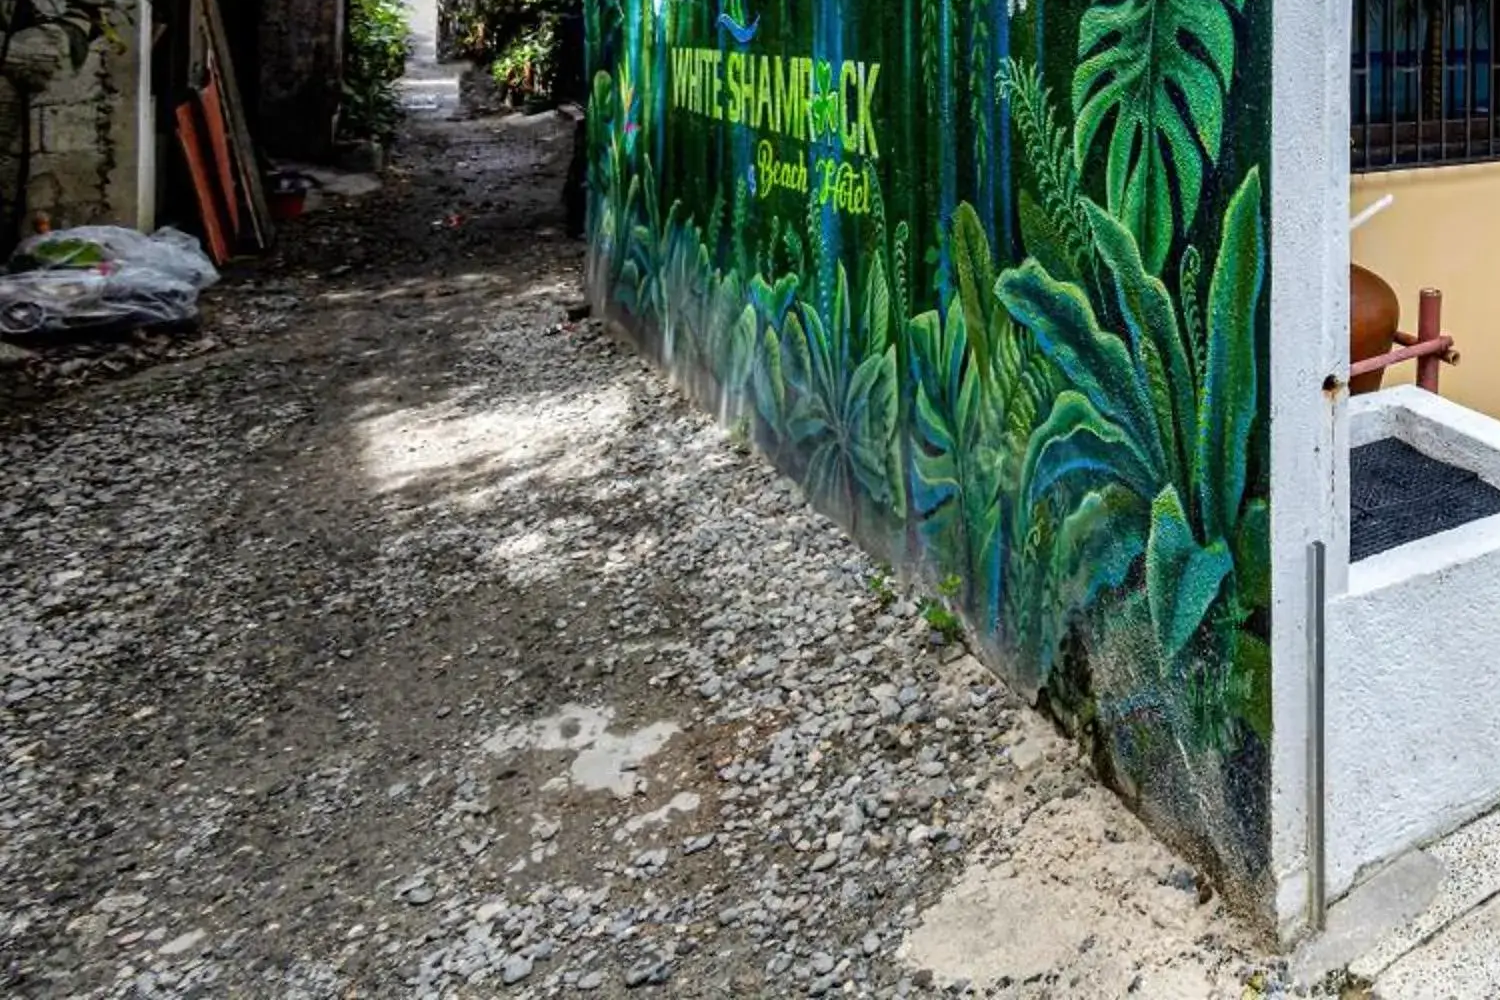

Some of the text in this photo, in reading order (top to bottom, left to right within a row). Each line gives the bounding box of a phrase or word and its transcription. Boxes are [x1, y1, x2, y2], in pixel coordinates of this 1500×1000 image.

[671, 47, 723, 121] WHITE
[757, 139, 871, 214] Beach Hotel
